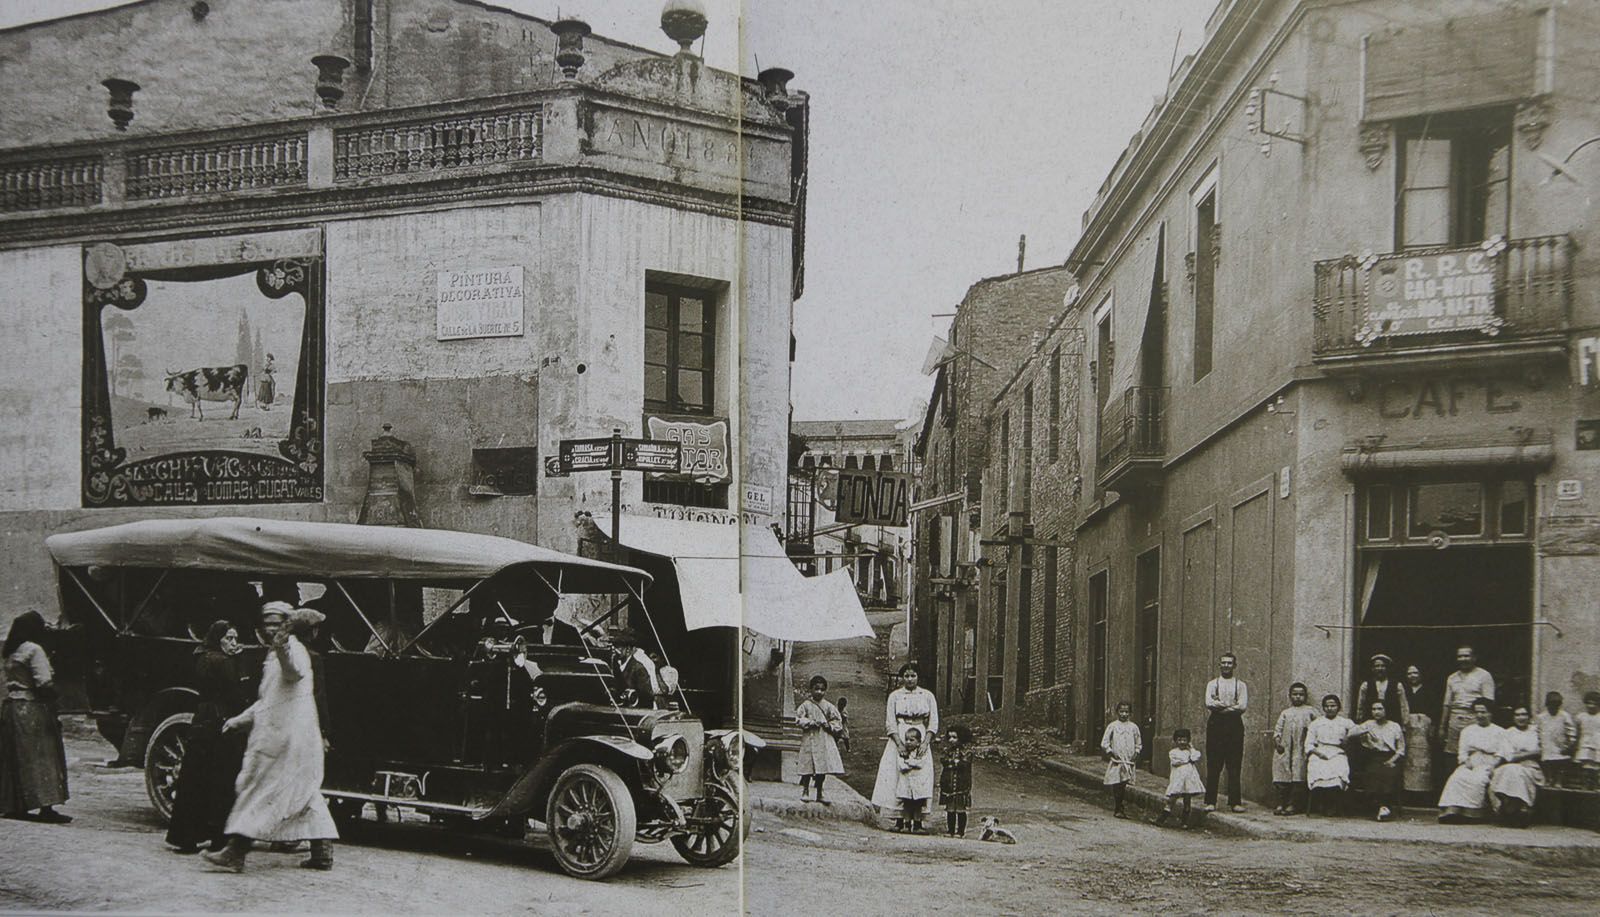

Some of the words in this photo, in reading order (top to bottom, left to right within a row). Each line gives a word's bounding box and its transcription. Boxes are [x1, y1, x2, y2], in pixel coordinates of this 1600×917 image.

[450, 271, 513, 288] PINTURA
[440, 286, 522, 303] DECORATIVA
[512, 320, 519, 333] 5
[1378, 380, 1522, 419] CAFE
[666, 427, 711, 446] GAS
[683, 447, 722, 470] TOR
[258, 479, 298, 499] CUGAT
[747, 491, 765, 502] GEL
[838, 474, 908, 526] FONDA
